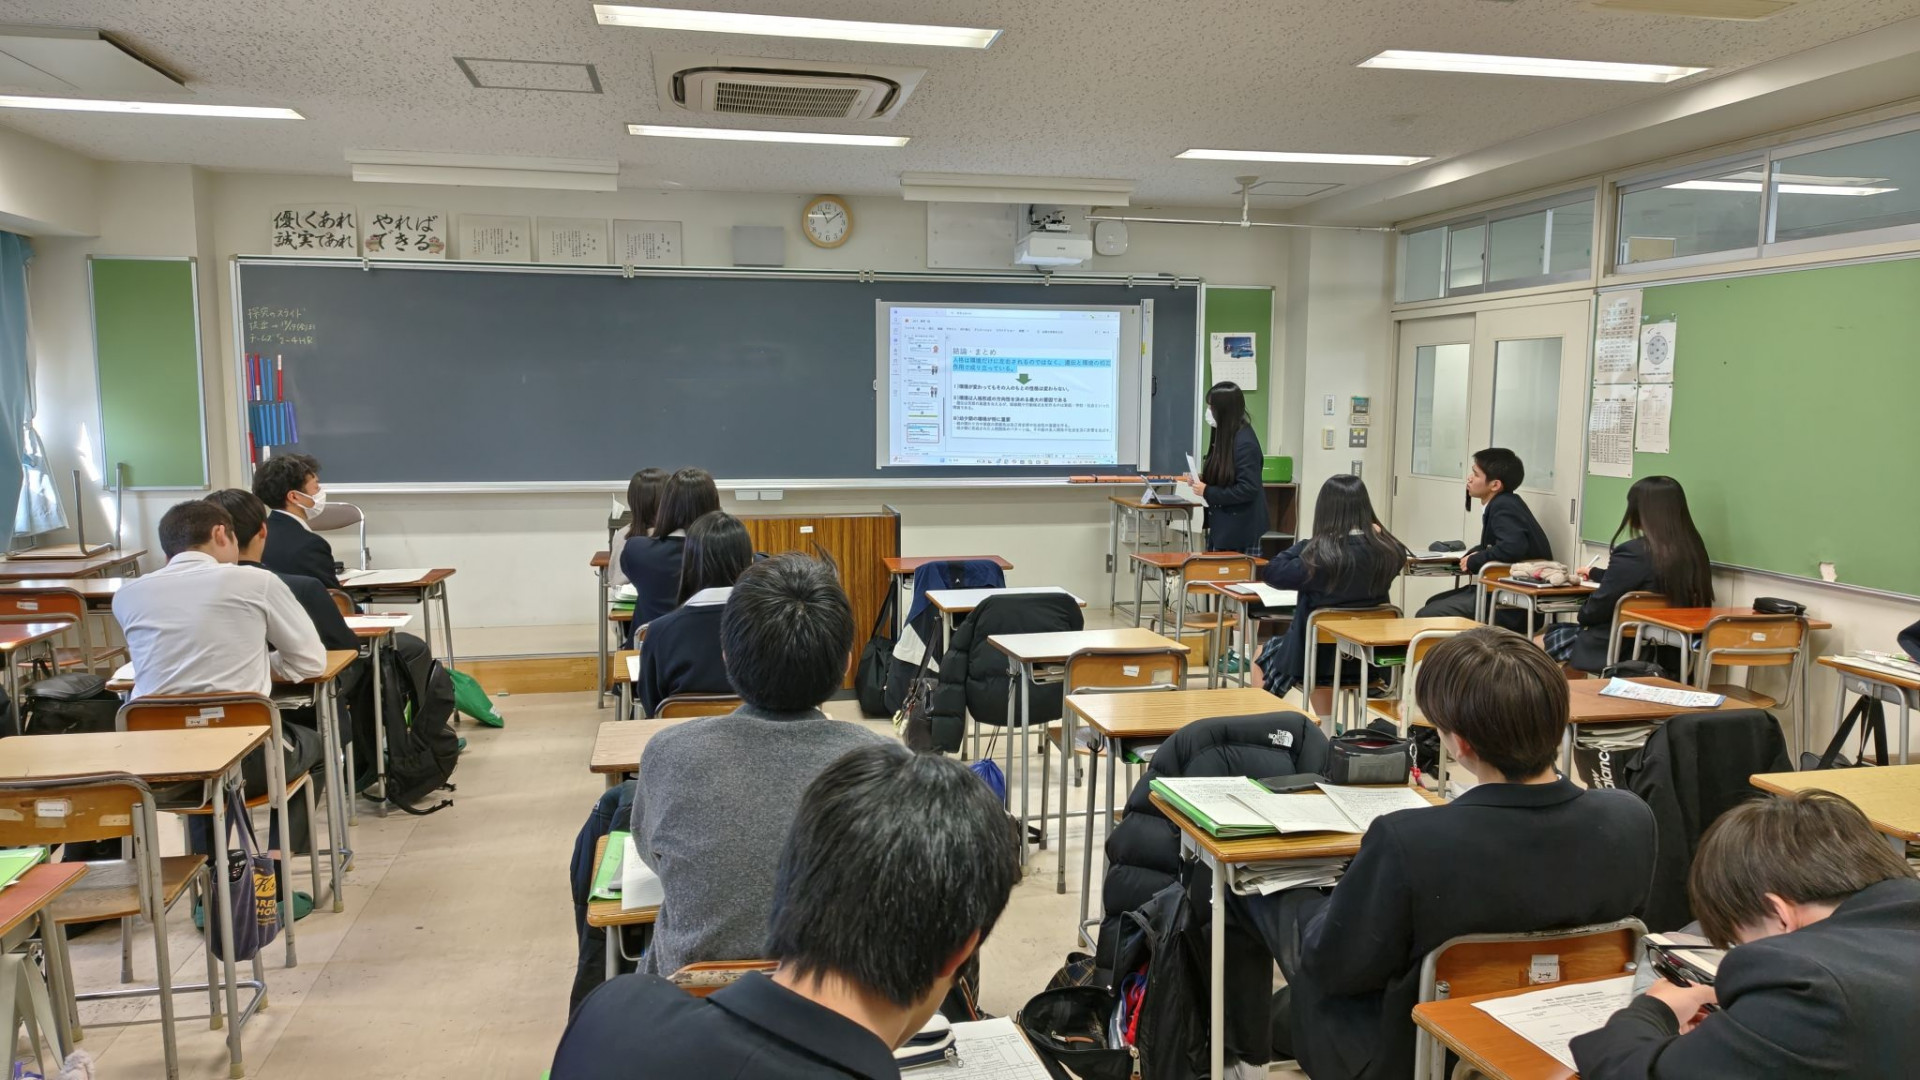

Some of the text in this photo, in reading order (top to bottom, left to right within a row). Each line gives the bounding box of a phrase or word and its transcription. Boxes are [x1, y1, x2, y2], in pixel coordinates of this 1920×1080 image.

[273, 210, 356, 230] 優しくあれ
[372, 213, 439, 233] やれば
[372, 230, 431, 251] できる
